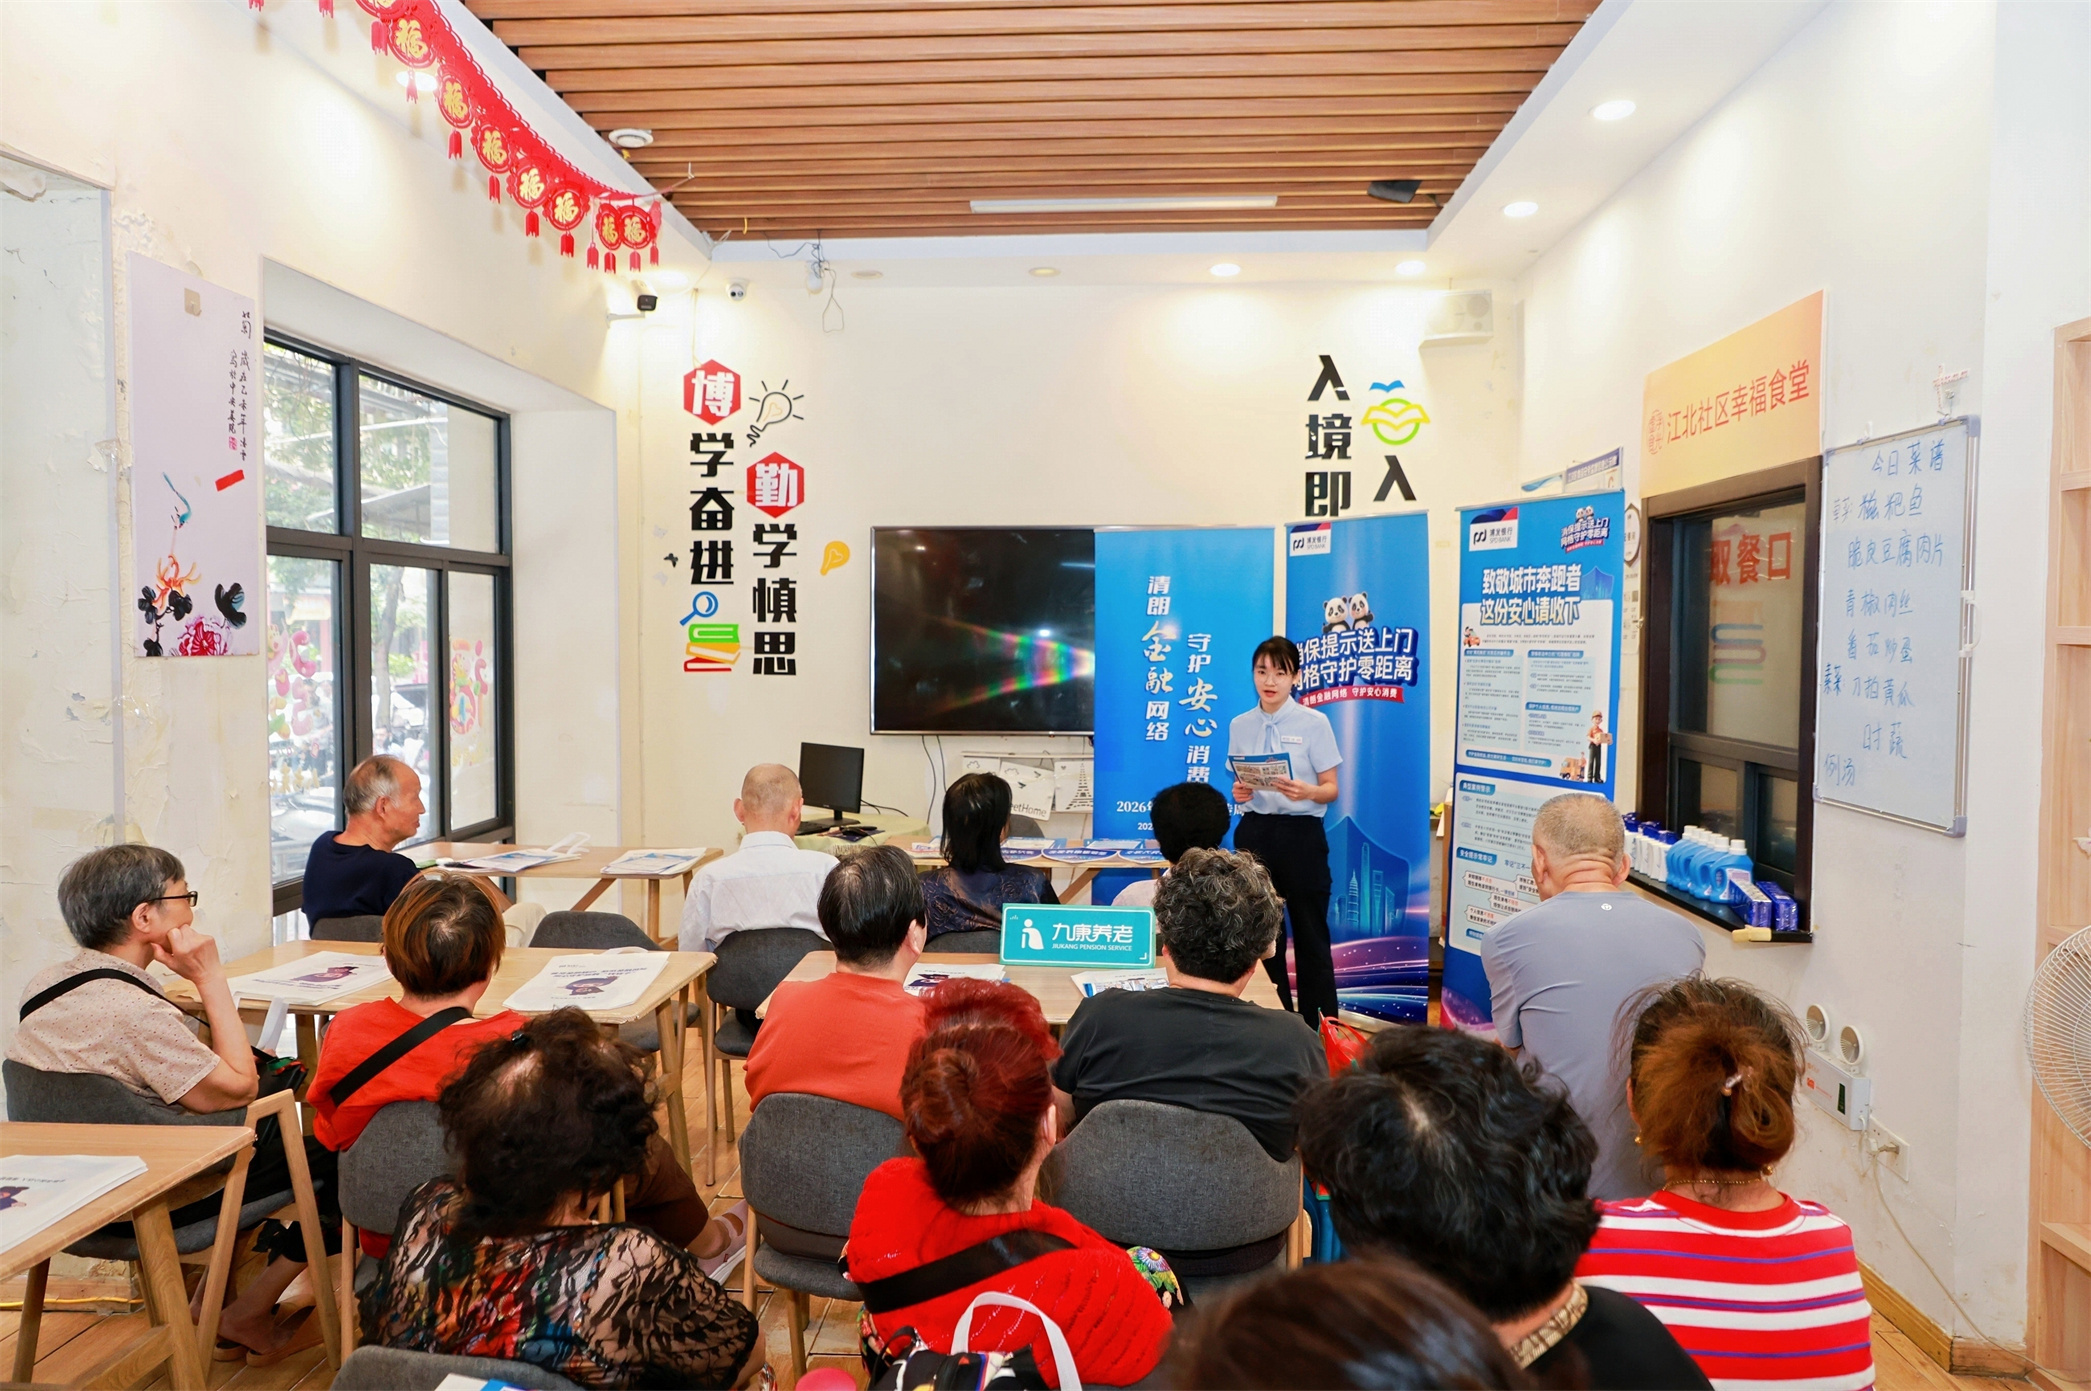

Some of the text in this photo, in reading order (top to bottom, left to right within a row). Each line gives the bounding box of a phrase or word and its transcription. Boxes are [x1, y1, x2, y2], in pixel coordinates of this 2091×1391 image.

[395, 18, 428, 58] 福
[519, 168, 545, 200] 福
[554, 192, 579, 223] 福
[623, 216, 646, 243] 福
[1667, 359, 1810, 445] 江北社区幸福食堂
[690, 369, 735, 585] 博学奋进
[753, 462, 798, 676] 勤学慎思
[1710, 531, 1792, 586] 取餐口
[1482, 564, 1581, 595] 致敬城市奔跑者
[1481, 597, 1579, 625] 这份安心请收下
[1846, 589, 1913, 618] 青椒肉丝
[1141, 575, 1178, 742] 清朗金融网络
[1847, 628, 1913, 664] 番茄炒蛋
[1052, 922, 1133, 943] 九康养老
